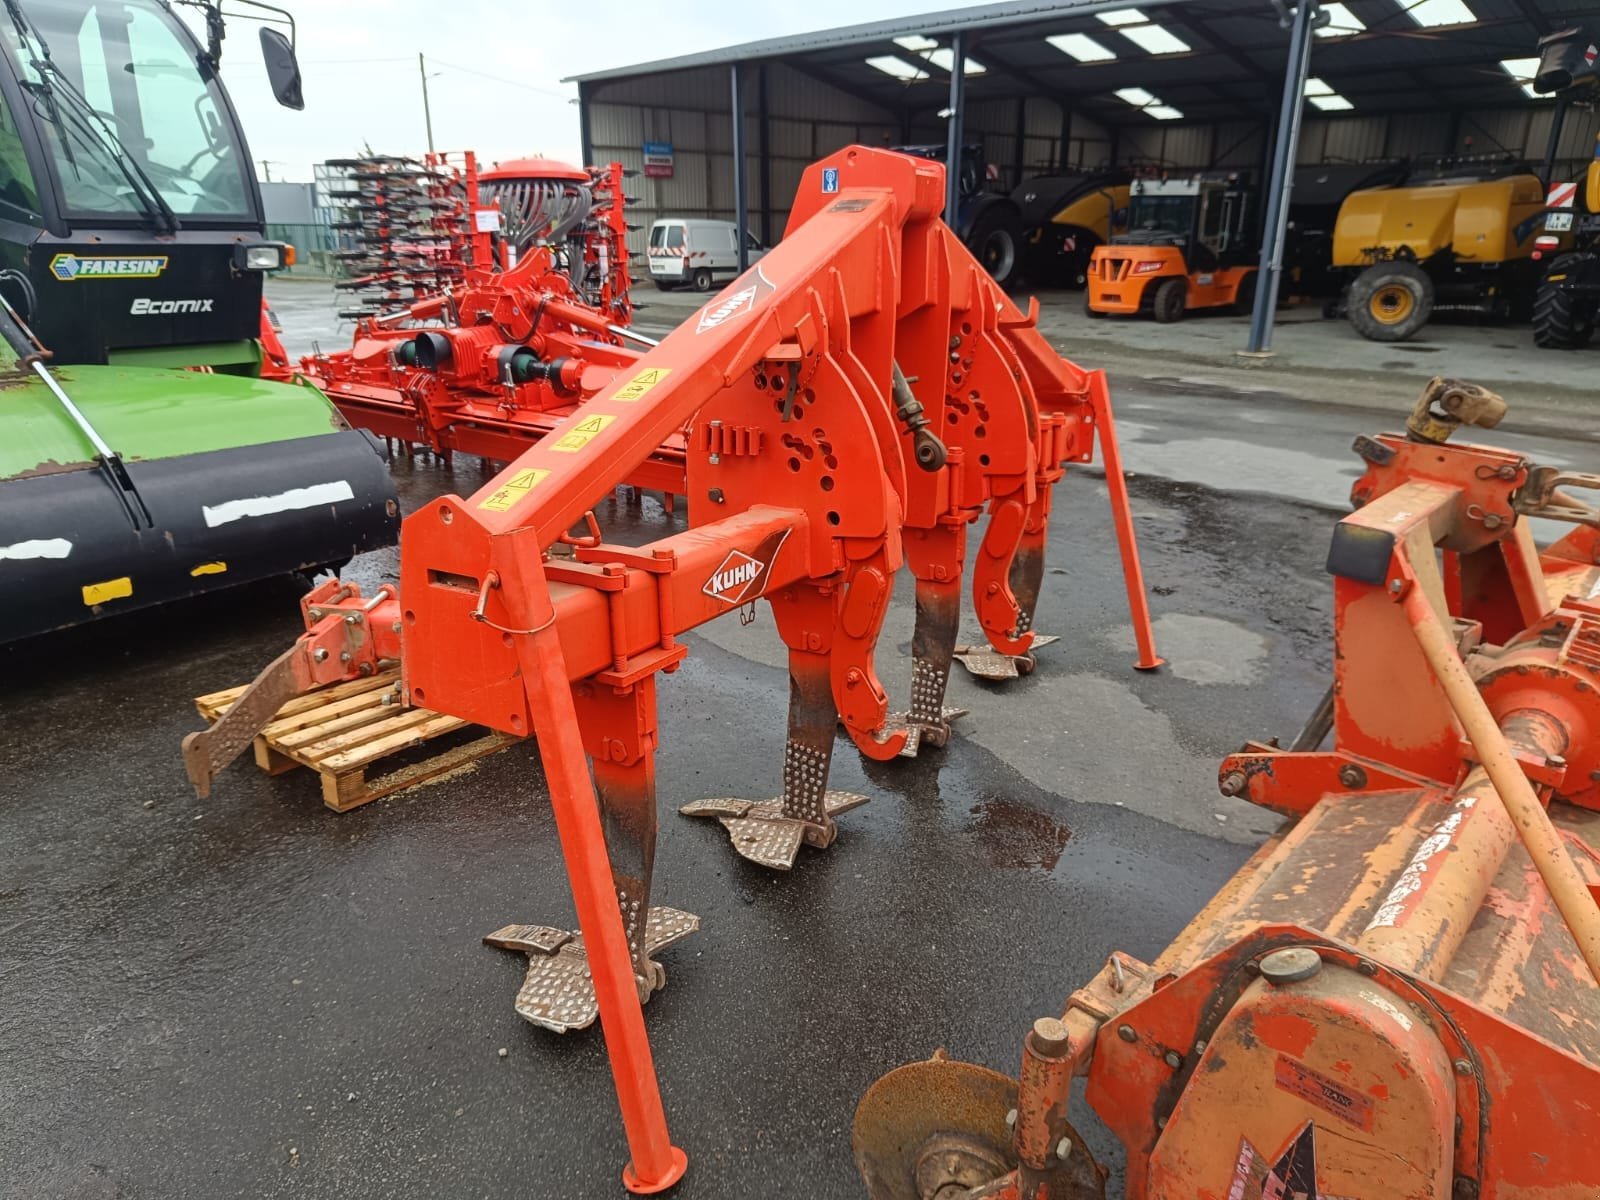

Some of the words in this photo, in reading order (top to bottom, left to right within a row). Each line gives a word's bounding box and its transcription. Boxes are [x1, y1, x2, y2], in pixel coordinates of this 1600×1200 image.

[80, 260, 159, 274] FARESIN
[130, 298, 214, 315] ecomix
[702, 290, 753, 327] KUHN
[712, 561, 756, 594] KUHN
